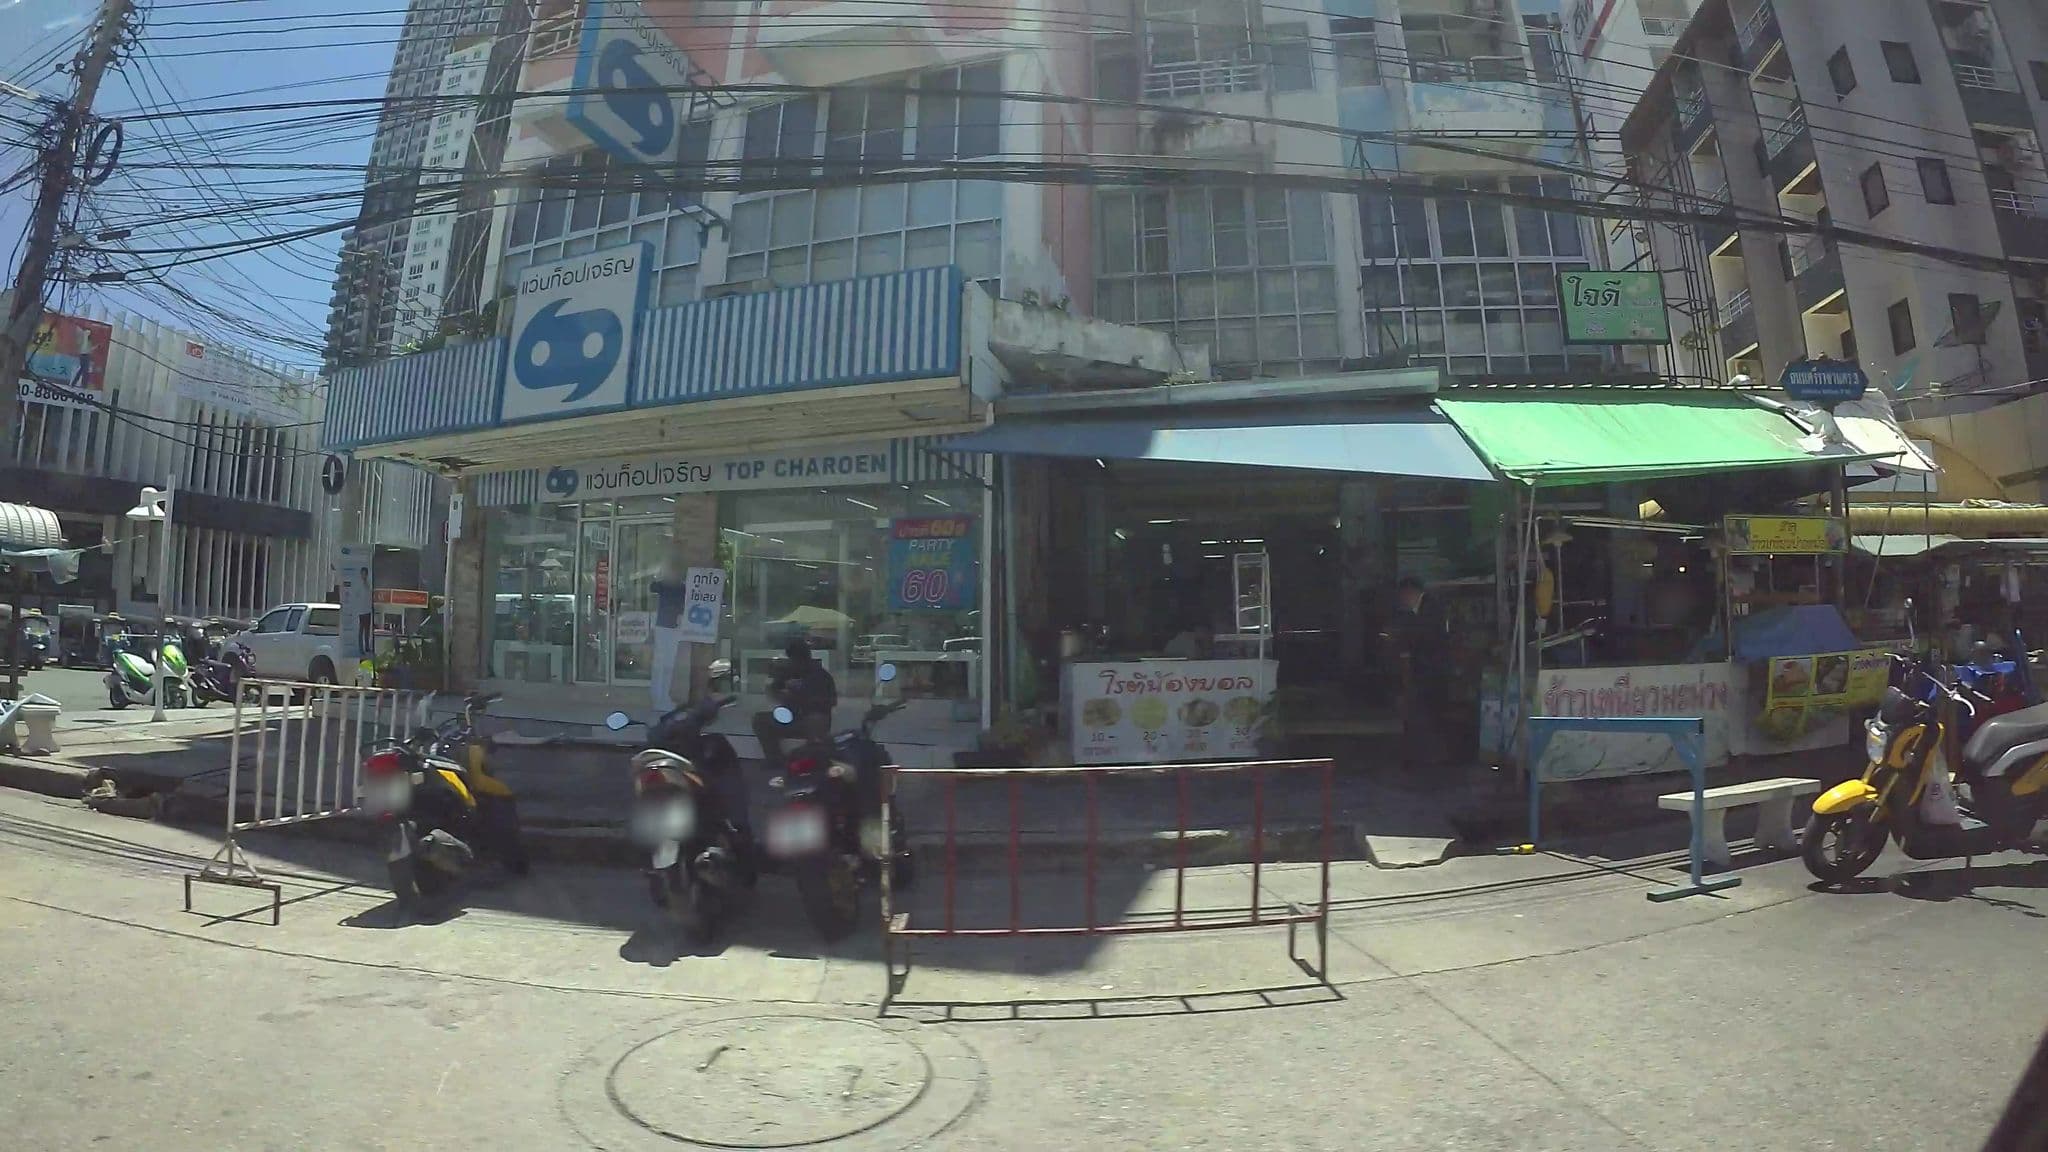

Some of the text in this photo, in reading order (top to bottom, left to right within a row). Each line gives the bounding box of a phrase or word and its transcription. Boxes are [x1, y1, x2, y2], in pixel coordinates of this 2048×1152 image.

[521, 257, 635, 295] แว่นท็อปเจริญ
[1566, 275, 1622, 307] ใจดี
[586, 453, 887, 490] แว่นท็อปเจริญ TOP CHAROEN
[909, 537, 956, 552] PARTY
[902, 568, 948, 602] 60
[1099, 669, 1254, 695] โรตีน้องบอล
